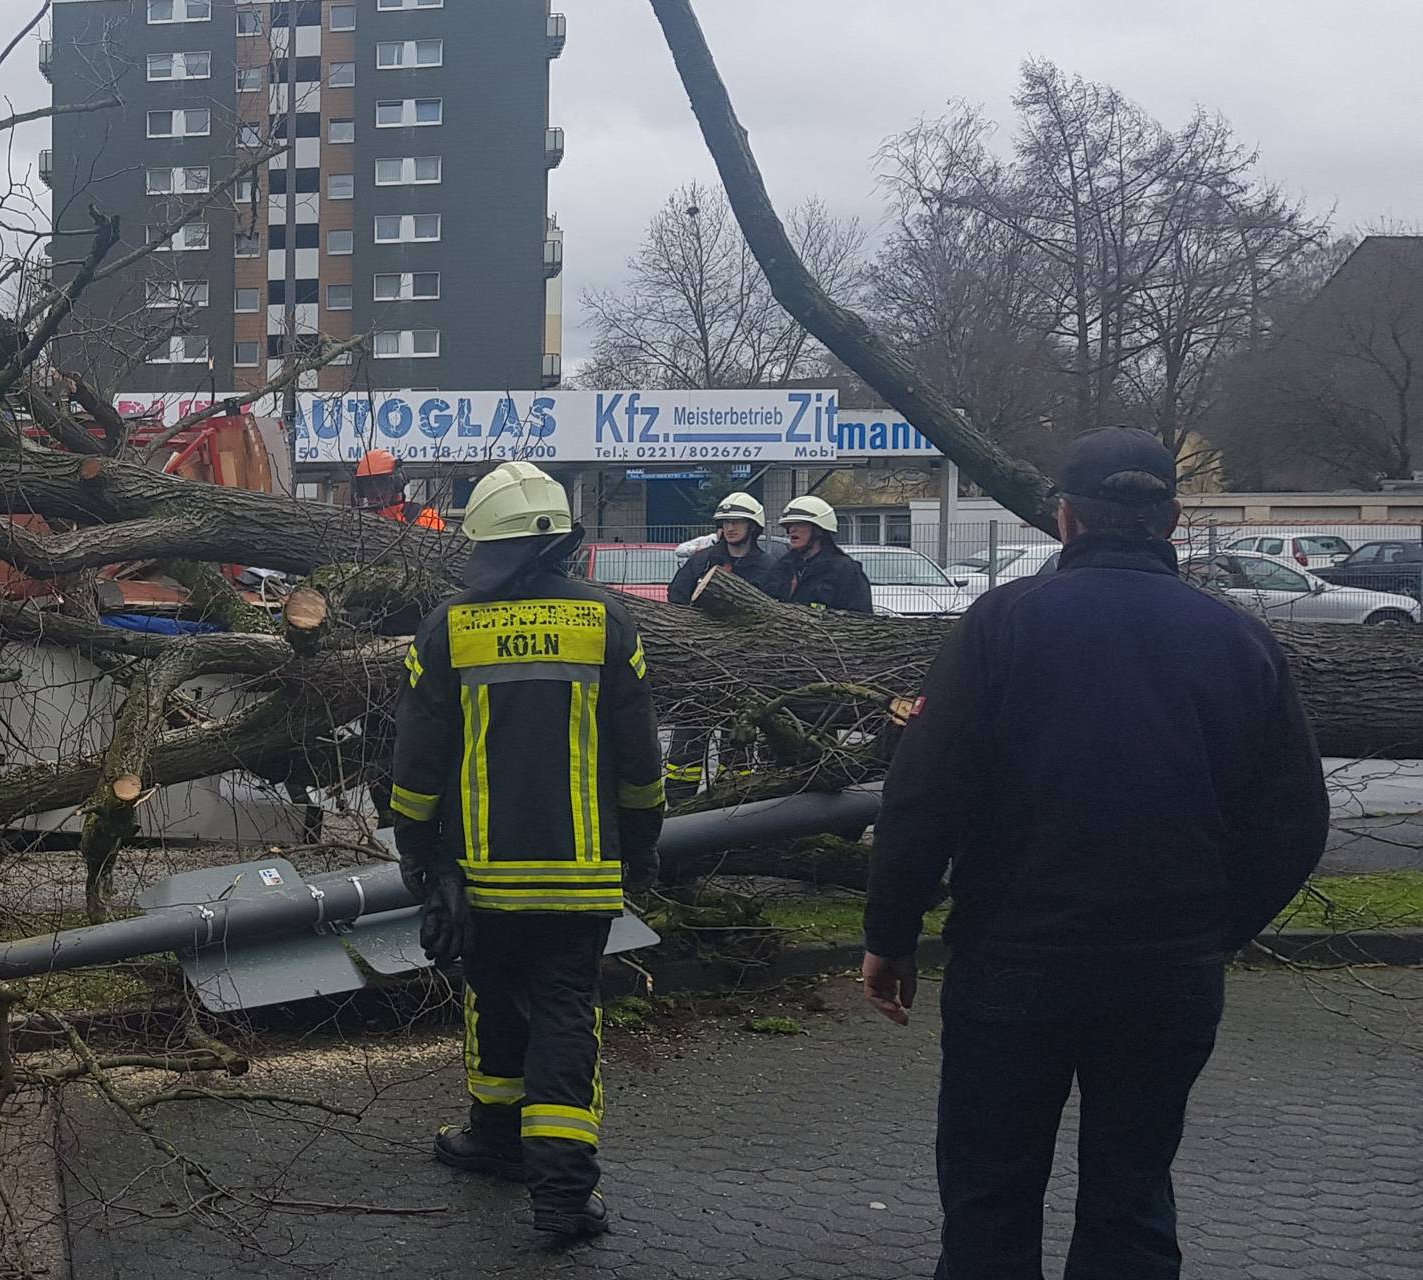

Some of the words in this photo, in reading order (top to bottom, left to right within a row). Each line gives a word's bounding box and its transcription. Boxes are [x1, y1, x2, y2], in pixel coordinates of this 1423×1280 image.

[595, 393, 670, 443] Kfz.
[674, 406, 783, 426] Meisterbetrieb
[785, 393, 838, 443] Zit
[408, 446, 452, 459] 0178
[636, 446, 763, 459] 0221/8026767
[794, 446, 834, 458] Mobi
[496, 630, 559, 658] KÖLN
